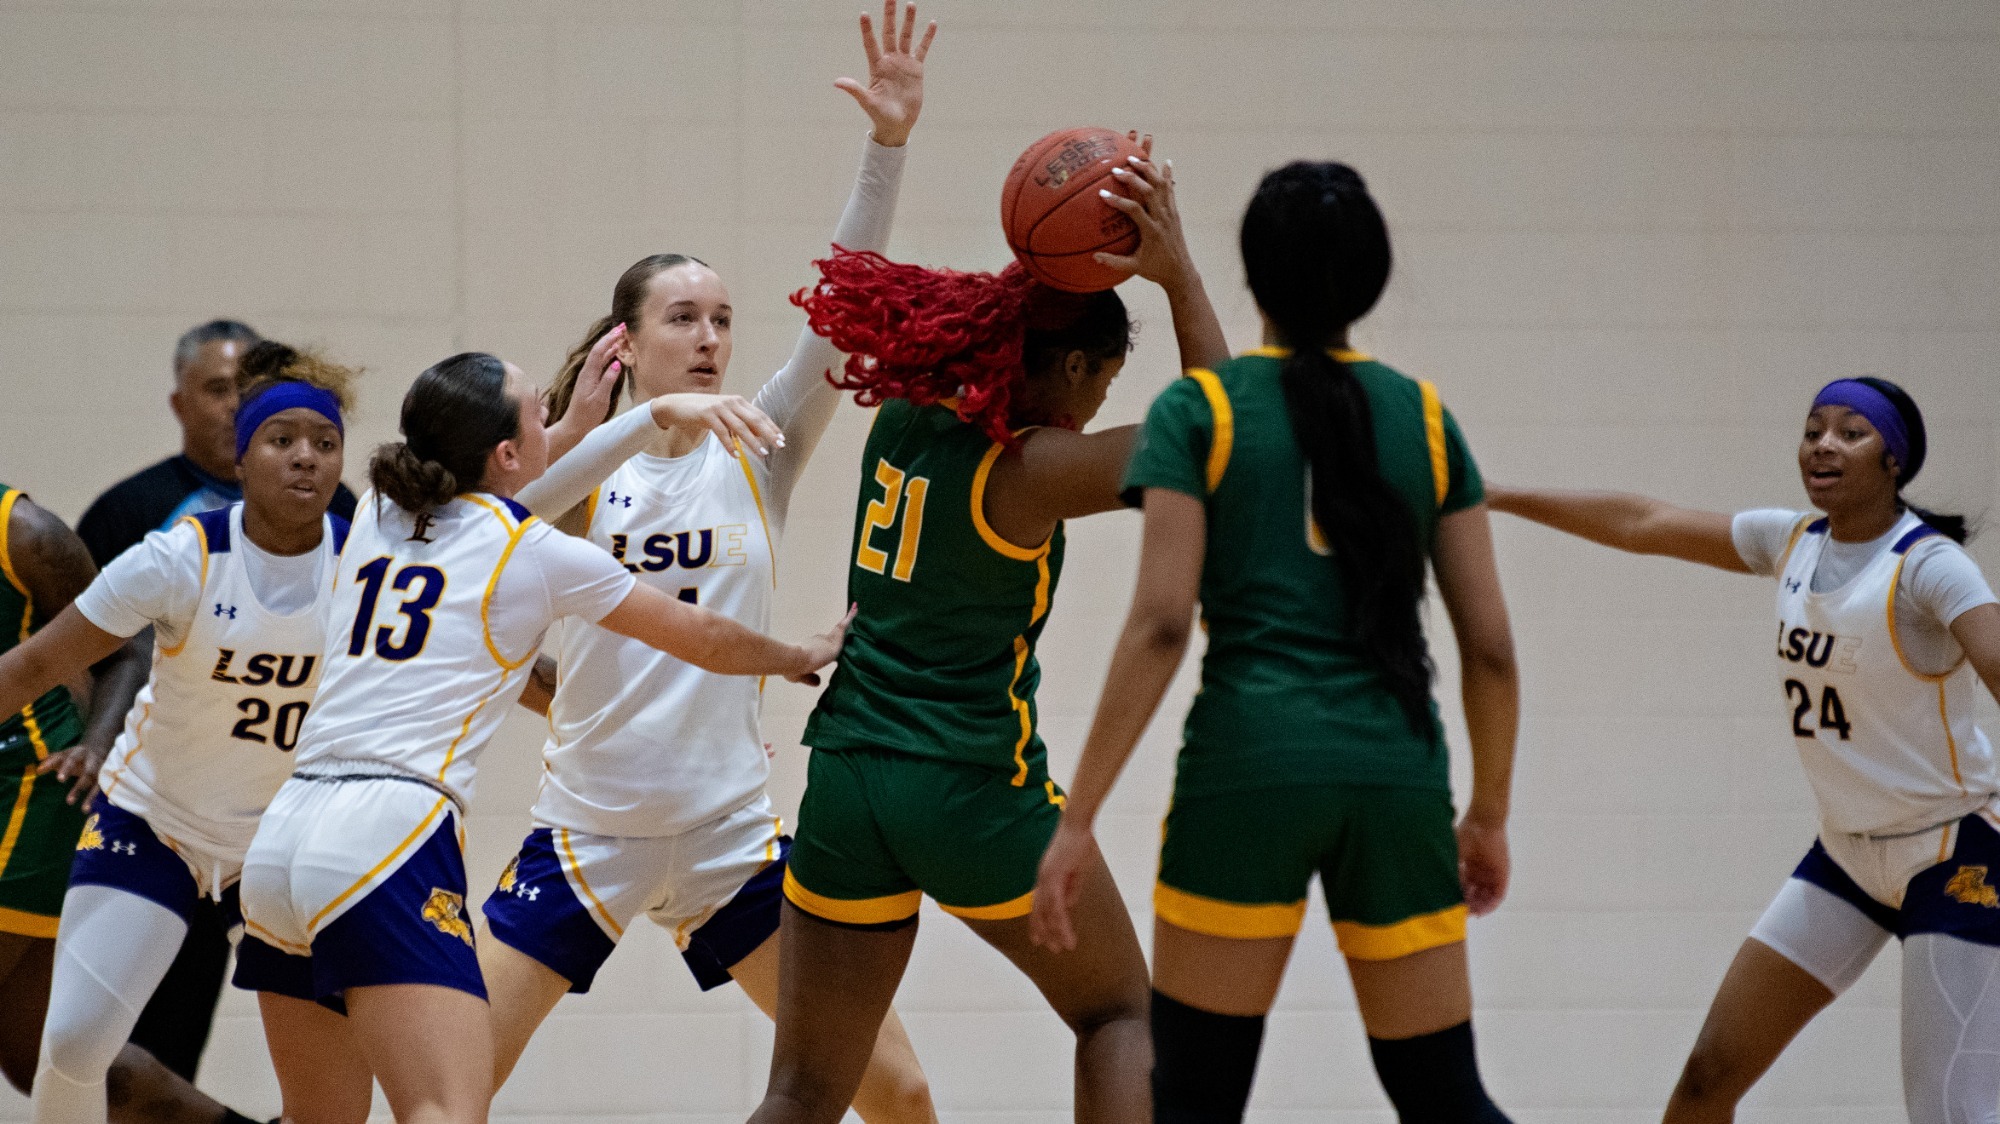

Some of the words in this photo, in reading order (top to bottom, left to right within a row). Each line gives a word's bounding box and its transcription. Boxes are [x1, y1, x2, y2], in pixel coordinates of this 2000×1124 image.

[856, 457, 930, 582] 21
[347, 555, 448, 664] 13
[230, 697, 310, 752] 20
[1785, 678, 1852, 741] 24
